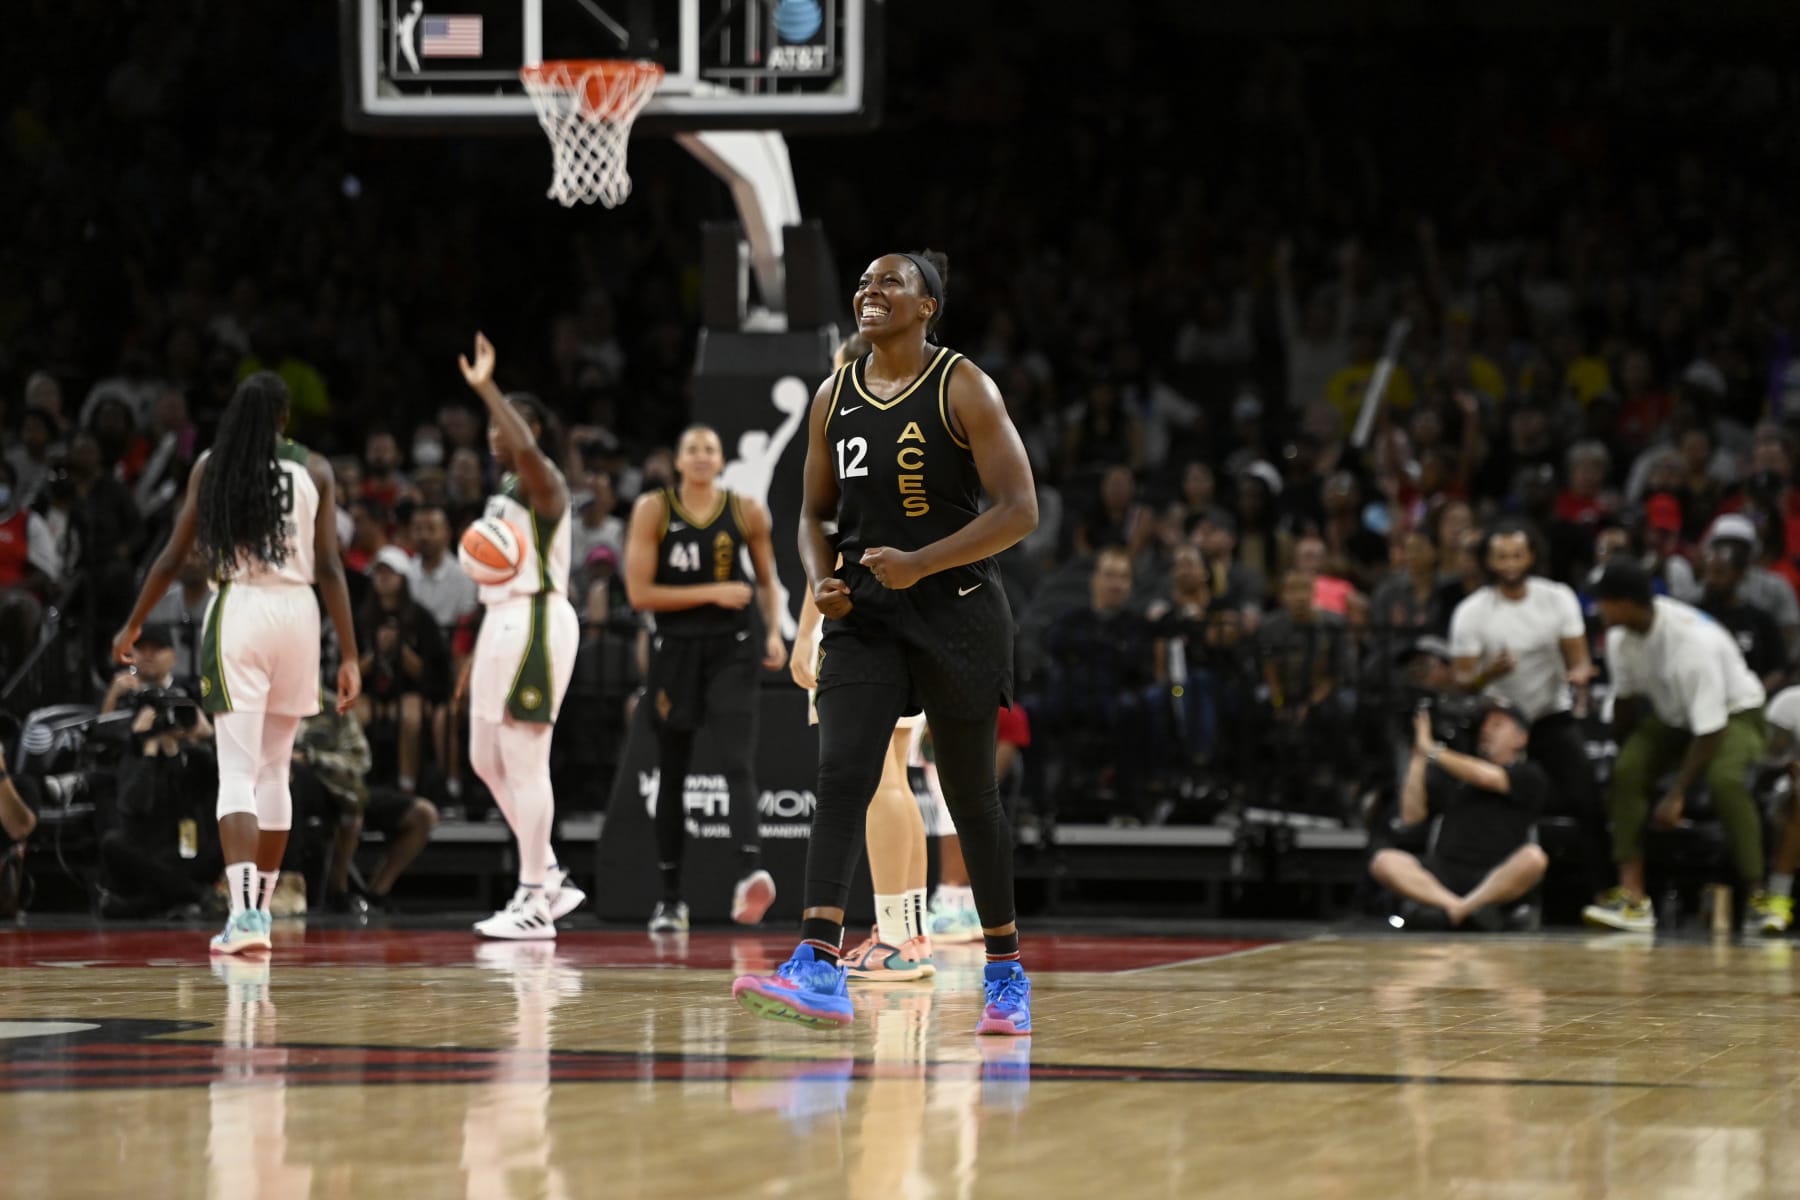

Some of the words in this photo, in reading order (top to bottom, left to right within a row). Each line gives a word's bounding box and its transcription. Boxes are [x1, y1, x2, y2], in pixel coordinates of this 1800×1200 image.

[767, 46, 828, 71] AT&T
[836, 436, 869, 479] 12
[896, 421, 930, 517] ACES
[669, 541, 700, 572] 41
